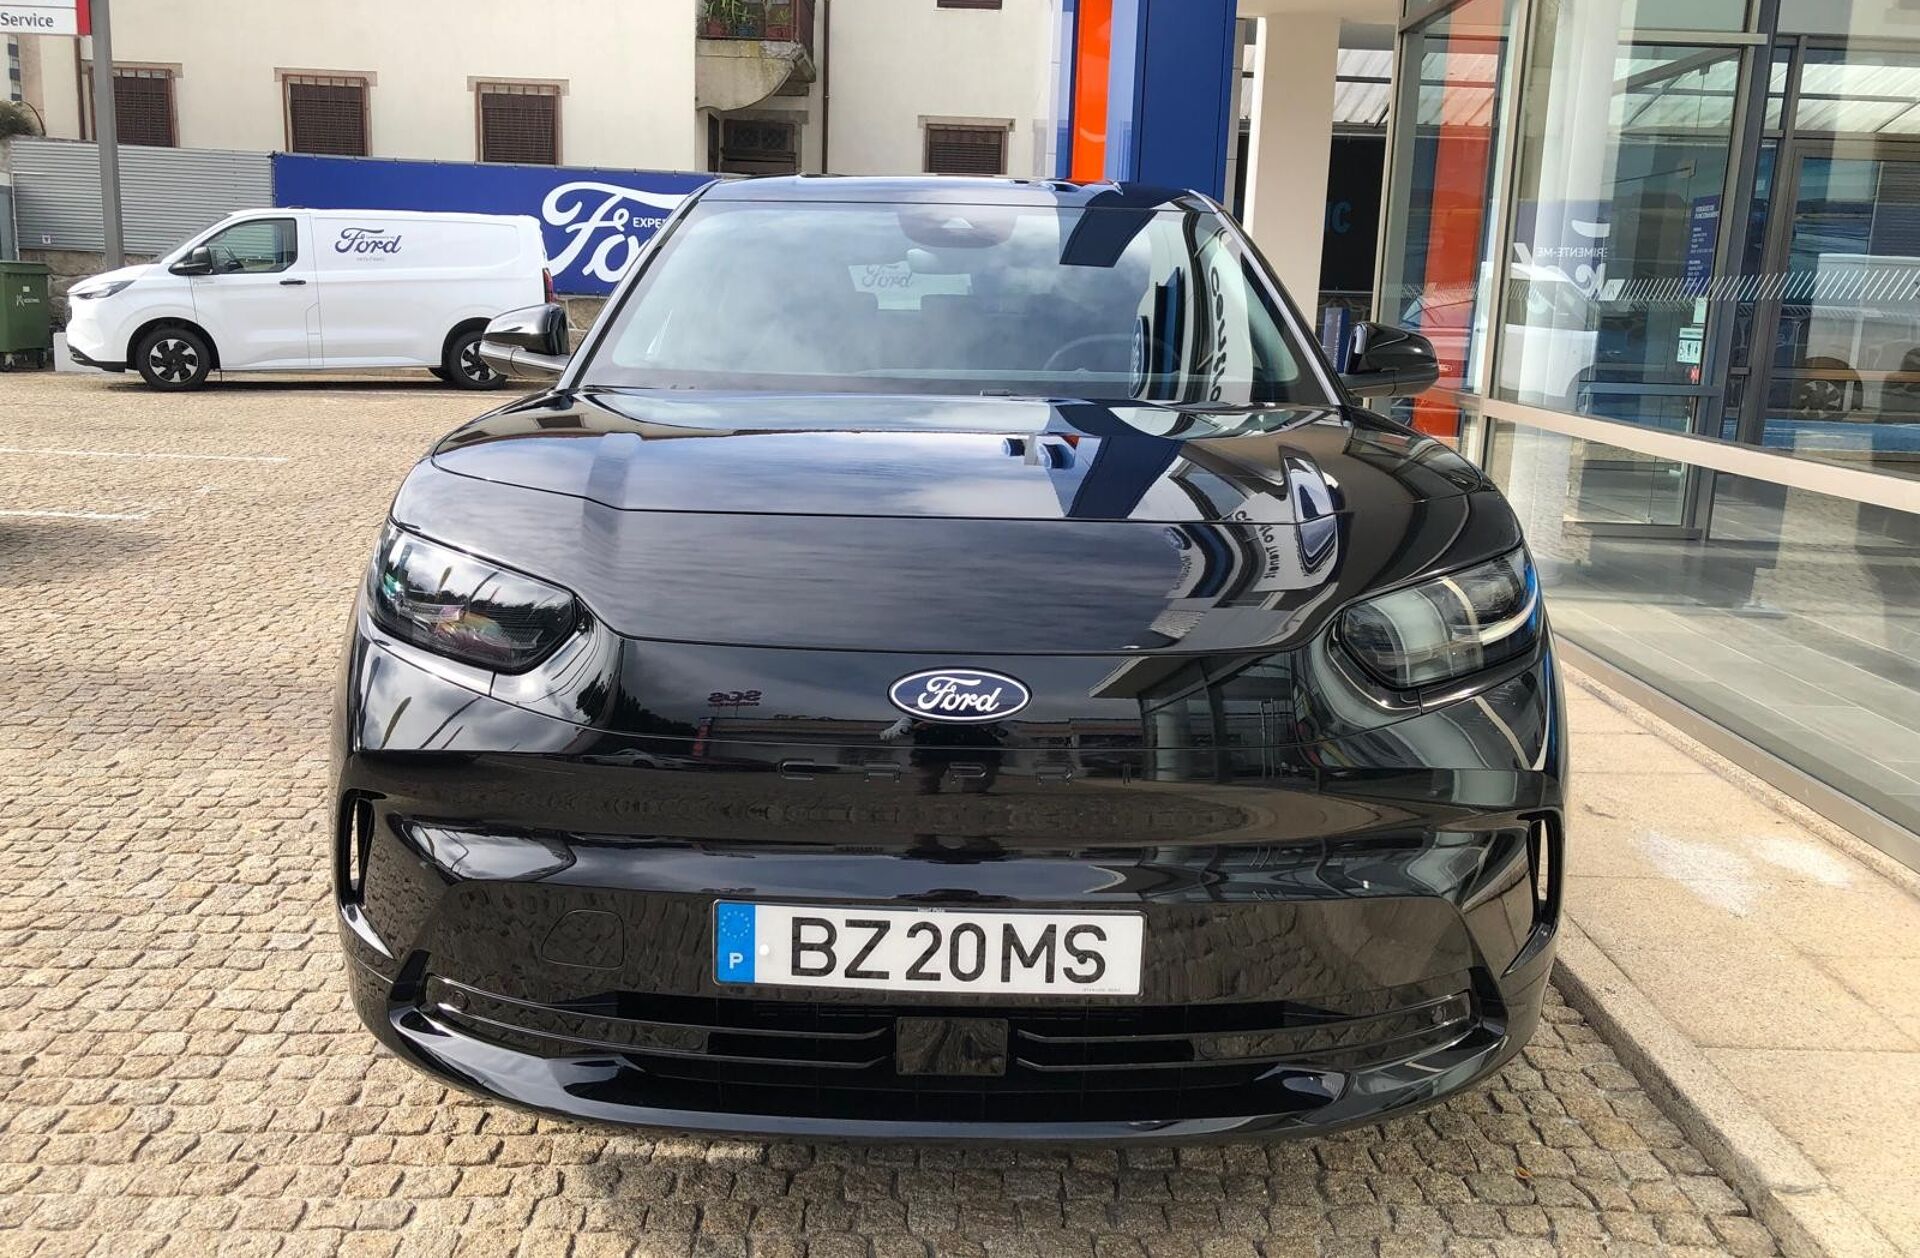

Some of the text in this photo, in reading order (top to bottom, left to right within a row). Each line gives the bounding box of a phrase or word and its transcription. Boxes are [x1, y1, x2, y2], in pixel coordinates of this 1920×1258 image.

[0, 12, 54, 28] Service
[335, 227, 402, 254] Ford
[917, 676, 1002, 712] Ford
[729, 952, 744, 969] P
[791, 917, 1107, 984] BZ 20 MS
